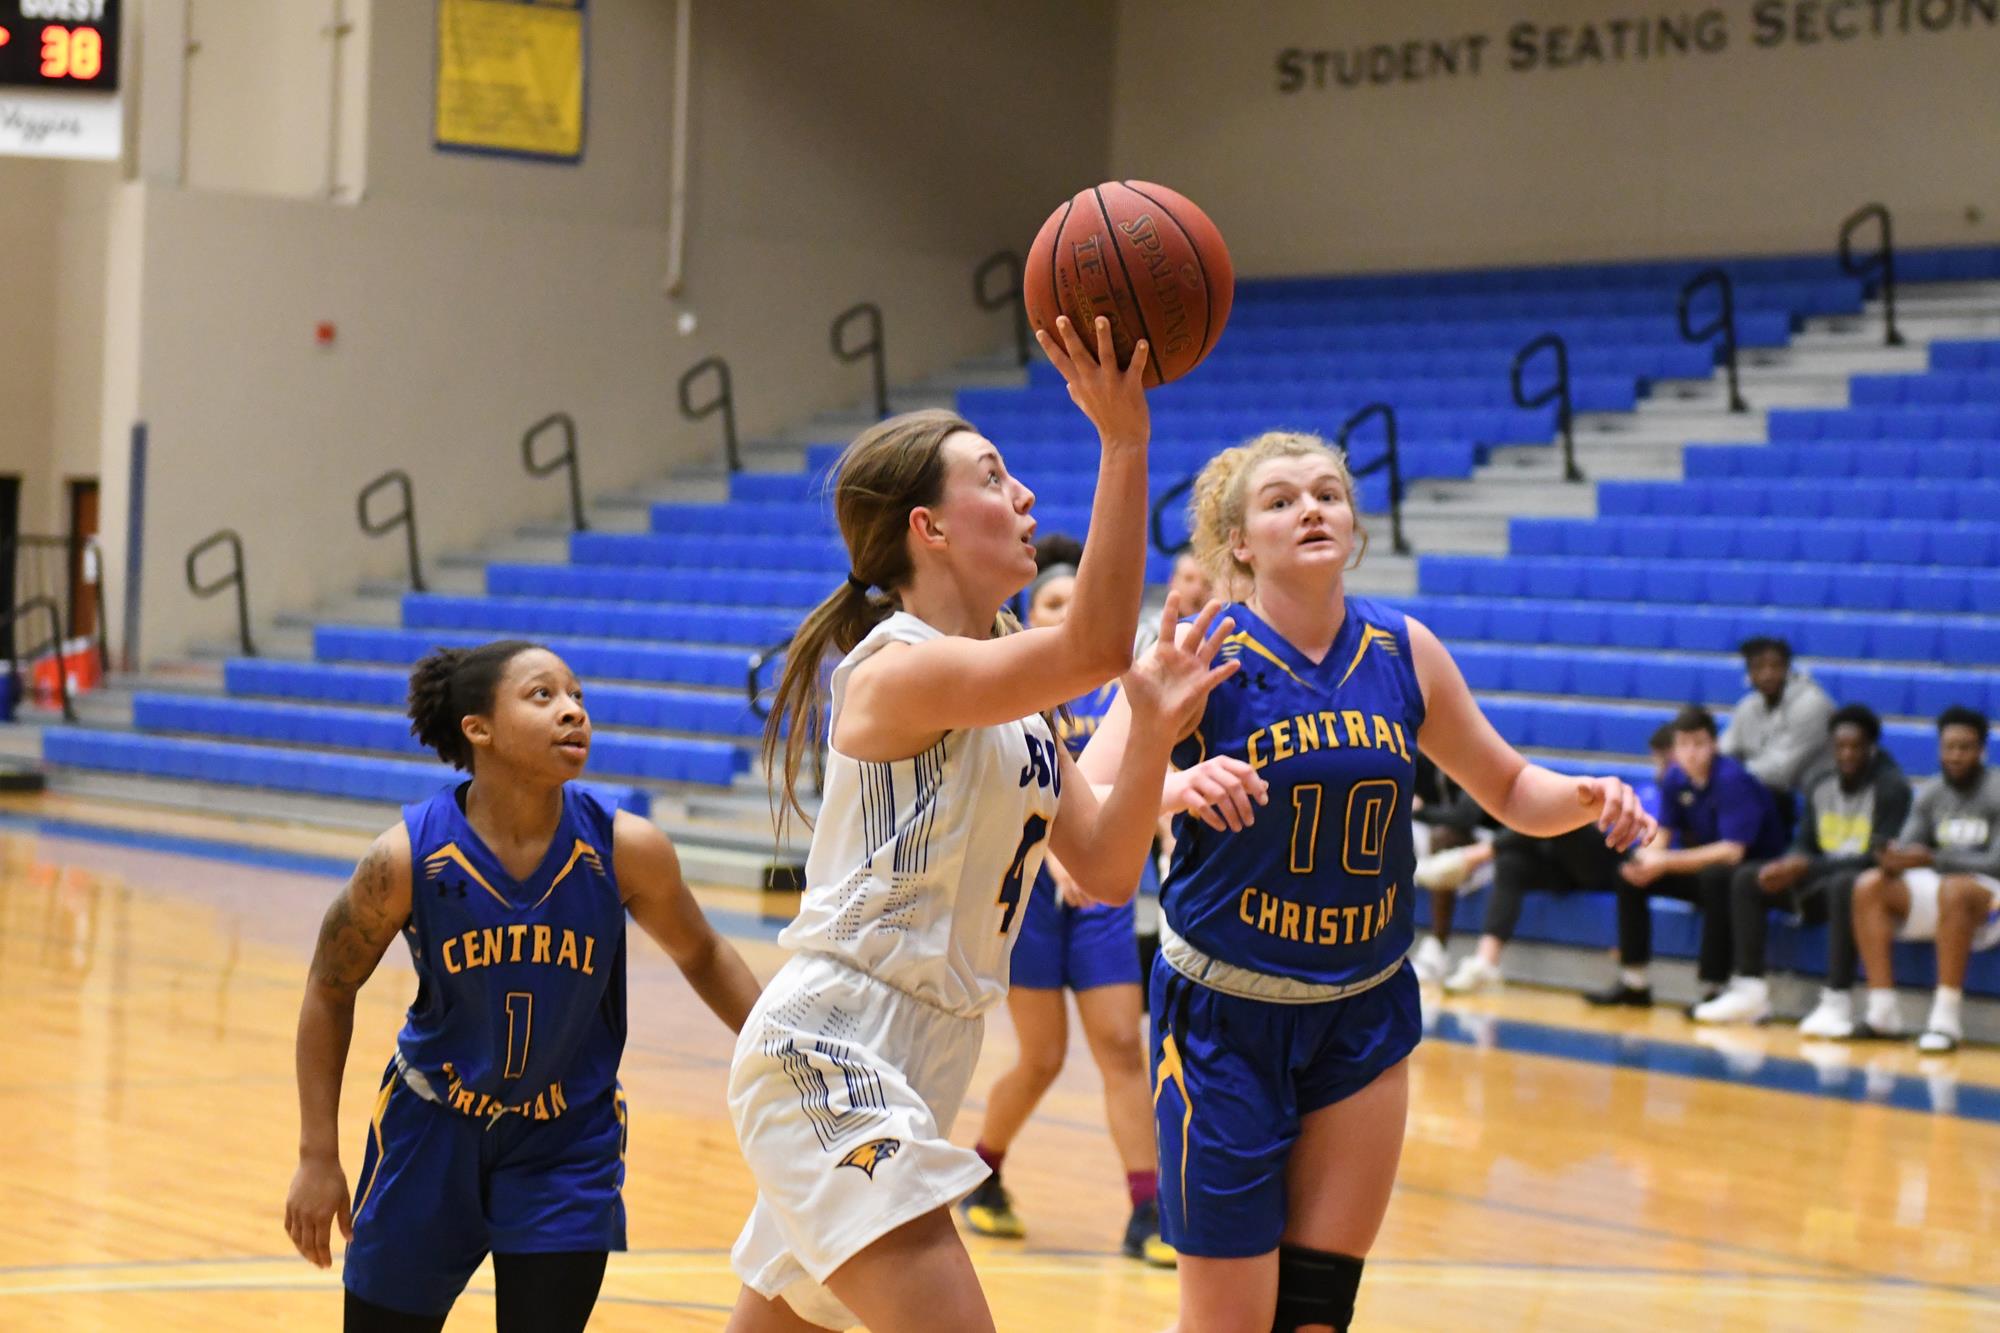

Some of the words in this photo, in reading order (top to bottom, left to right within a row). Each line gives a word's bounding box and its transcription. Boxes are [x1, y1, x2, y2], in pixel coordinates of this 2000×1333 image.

[40, 24, 102, 80] 38
[1277, 35, 1489, 93] STUDENT
[1508, 9, 1728, 71] SEATING
[1752, 0, 2000, 47] SECTION
[1118, 214, 1193, 358] SPALDING
[1246, 710, 1412, 771] CENTRAL
[1290, 779, 1398, 876] 10
[442, 924, 596, 977] CENTRAL
[1239, 882, 1398, 946] CHRISTIAN
[504, 992, 533, 1079] 1
